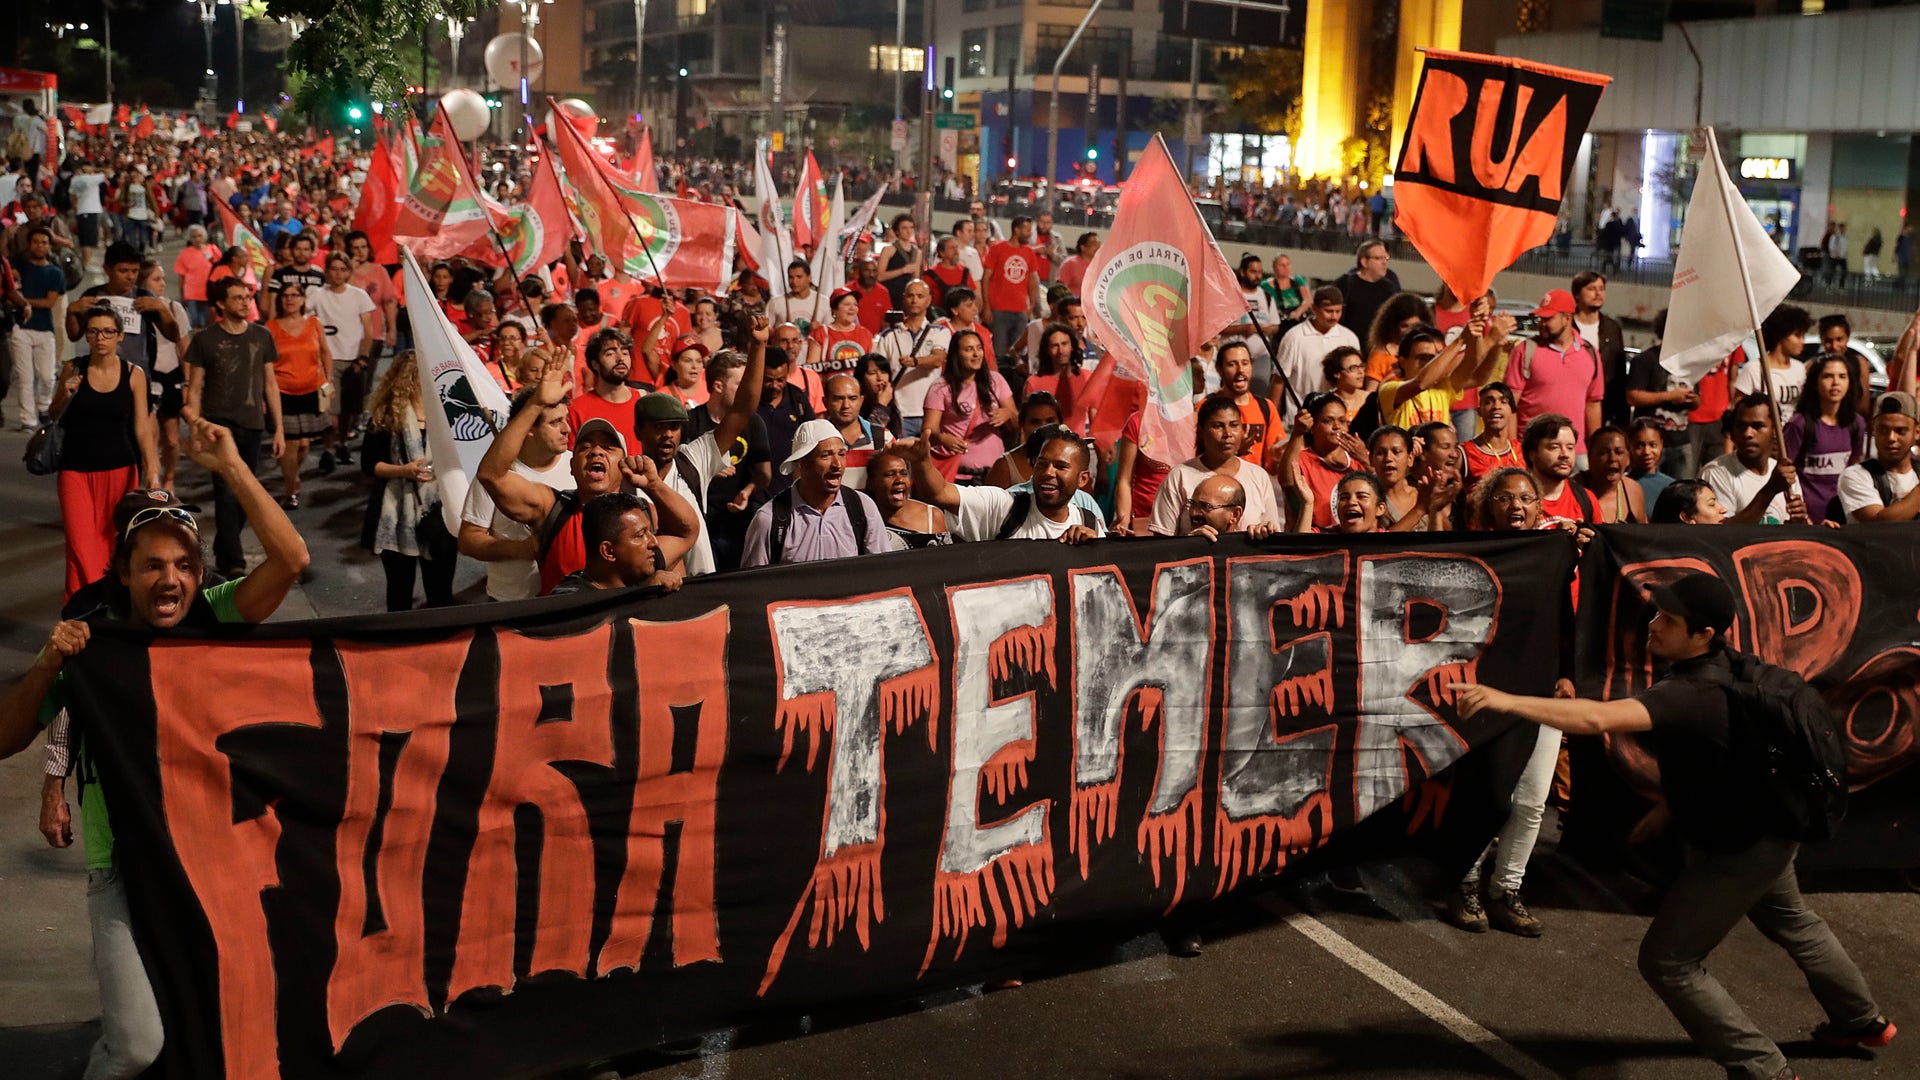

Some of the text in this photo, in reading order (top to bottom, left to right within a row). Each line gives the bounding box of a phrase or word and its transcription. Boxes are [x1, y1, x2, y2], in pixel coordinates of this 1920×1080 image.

[1401, 69, 1567, 201] RUA
[148, 549, 1503, 1080] FORA TEMER
